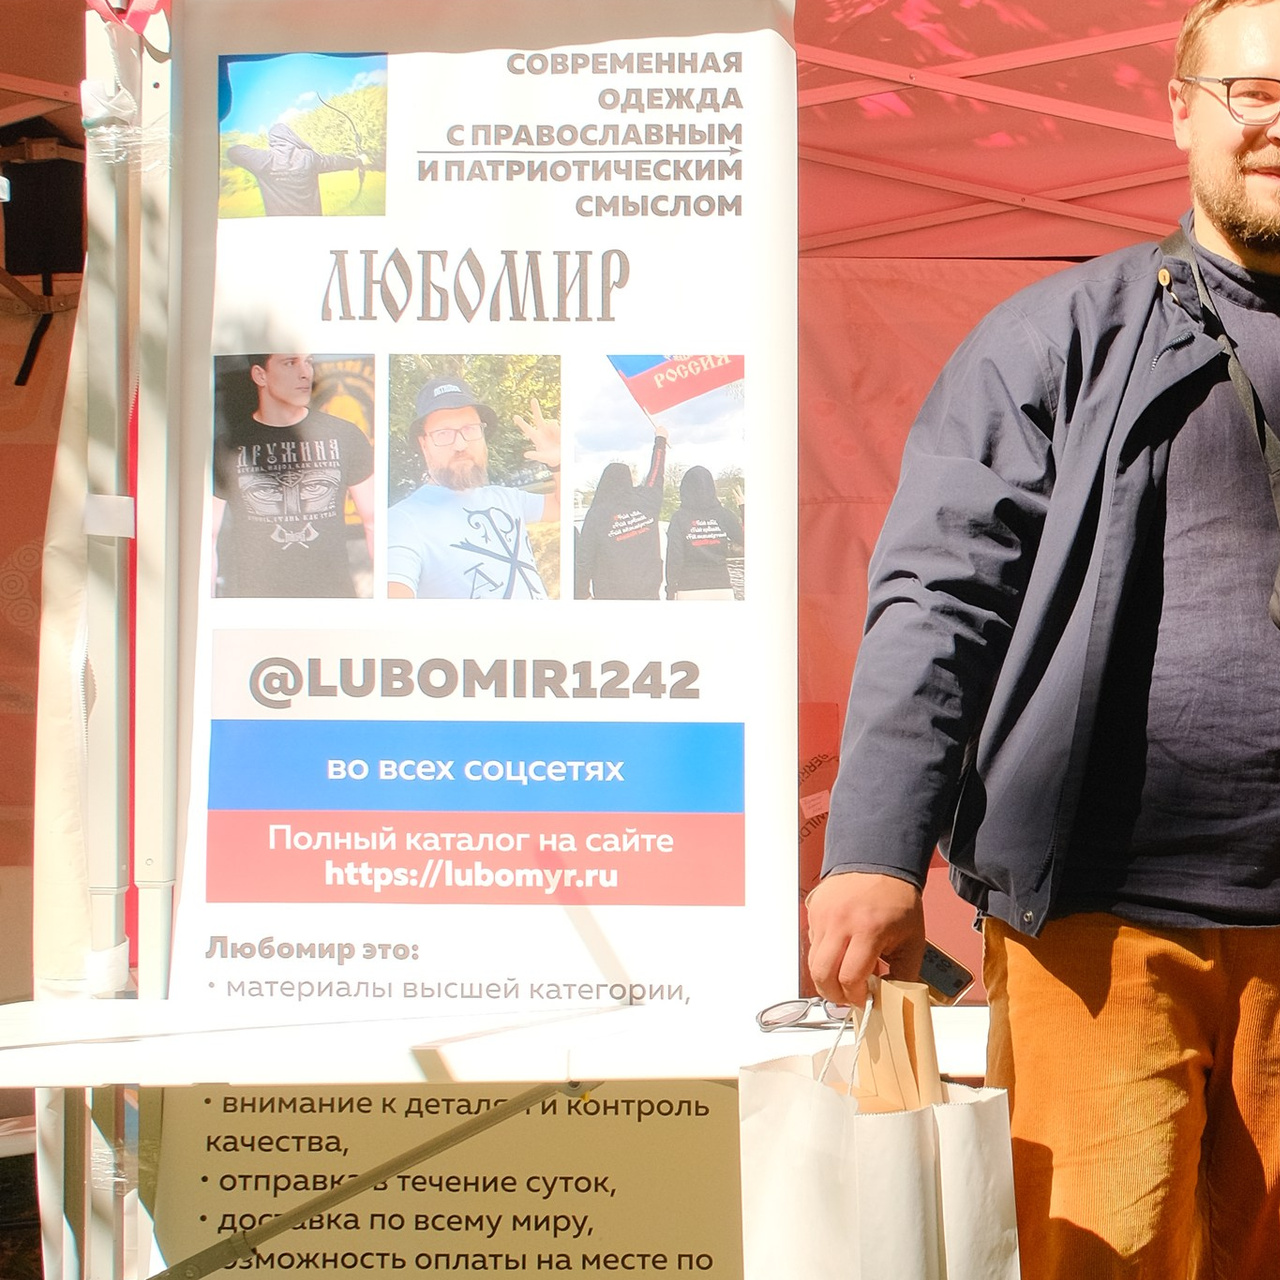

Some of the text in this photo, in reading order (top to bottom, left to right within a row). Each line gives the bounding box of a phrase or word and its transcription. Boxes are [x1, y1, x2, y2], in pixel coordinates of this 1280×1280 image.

[507, 51, 743, 76] СОВРЕМЕННАЯ
[598, 87, 744, 114] ОДЕЖДА
[447, 122, 743, 148] С ПРАВОСЛАВНЫМ
[418, 158, 743, 183] И ПАТРИОТИЧЕСКИМ
[576, 194, 743, 218] СМЫСЛОМ
[321, 247, 631, 324] ЛЮБОМИР
[653, 355, 731, 389] РОССИЯ
[249, 656, 700, 709] @LUBOMIR1242
[328, 759, 625, 786] во всех соцсетях
[269, 824, 674, 852] Полный каталог на сайте
[325, 859, 618, 894] https://lubomyr.ru
[205, 936, 420, 965] Любомир это:
[227, 978, 691, 1006] материалы высшей категории,
[223, 1096, 710, 1123] внимание к детал и контроль
[207, 1134, 349, 1157] качества,
[219, 1174, 359, 1198] отправк
[397, 1174, 518, 1193] течение
[525, 1175, 617, 1201] суток,
[369, 1213, 406, 1231] по
[414, 1213, 503, 1237] всему
[512, 1214, 594, 1238] миру,
[223, 1250, 714, 1271] зможность оплаты на месте по
